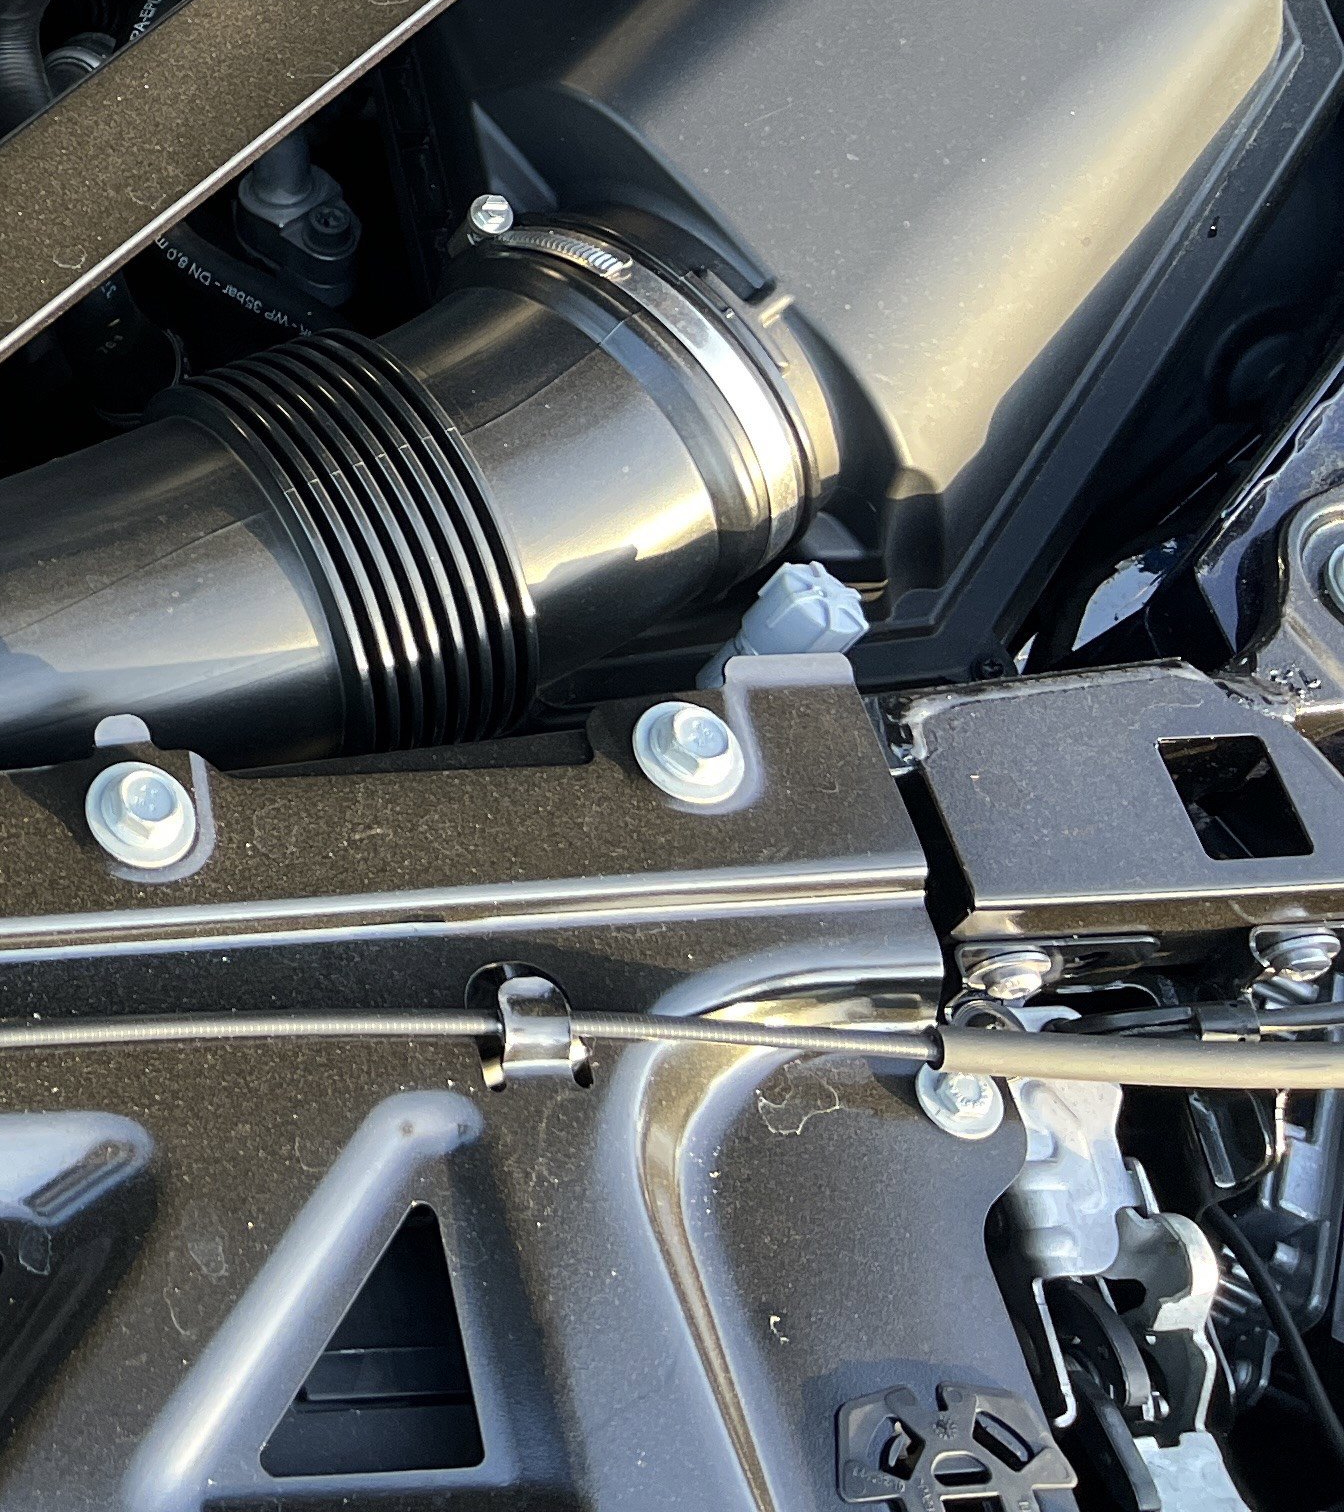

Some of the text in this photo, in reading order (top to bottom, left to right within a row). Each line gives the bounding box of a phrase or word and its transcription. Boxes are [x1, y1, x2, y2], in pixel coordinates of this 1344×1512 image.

[166, 248, 189, 269] 8,0
[188, 262, 212, 286] DN
[222, 284, 263, 314] 35bar
[264, 309, 289, 327] WP
